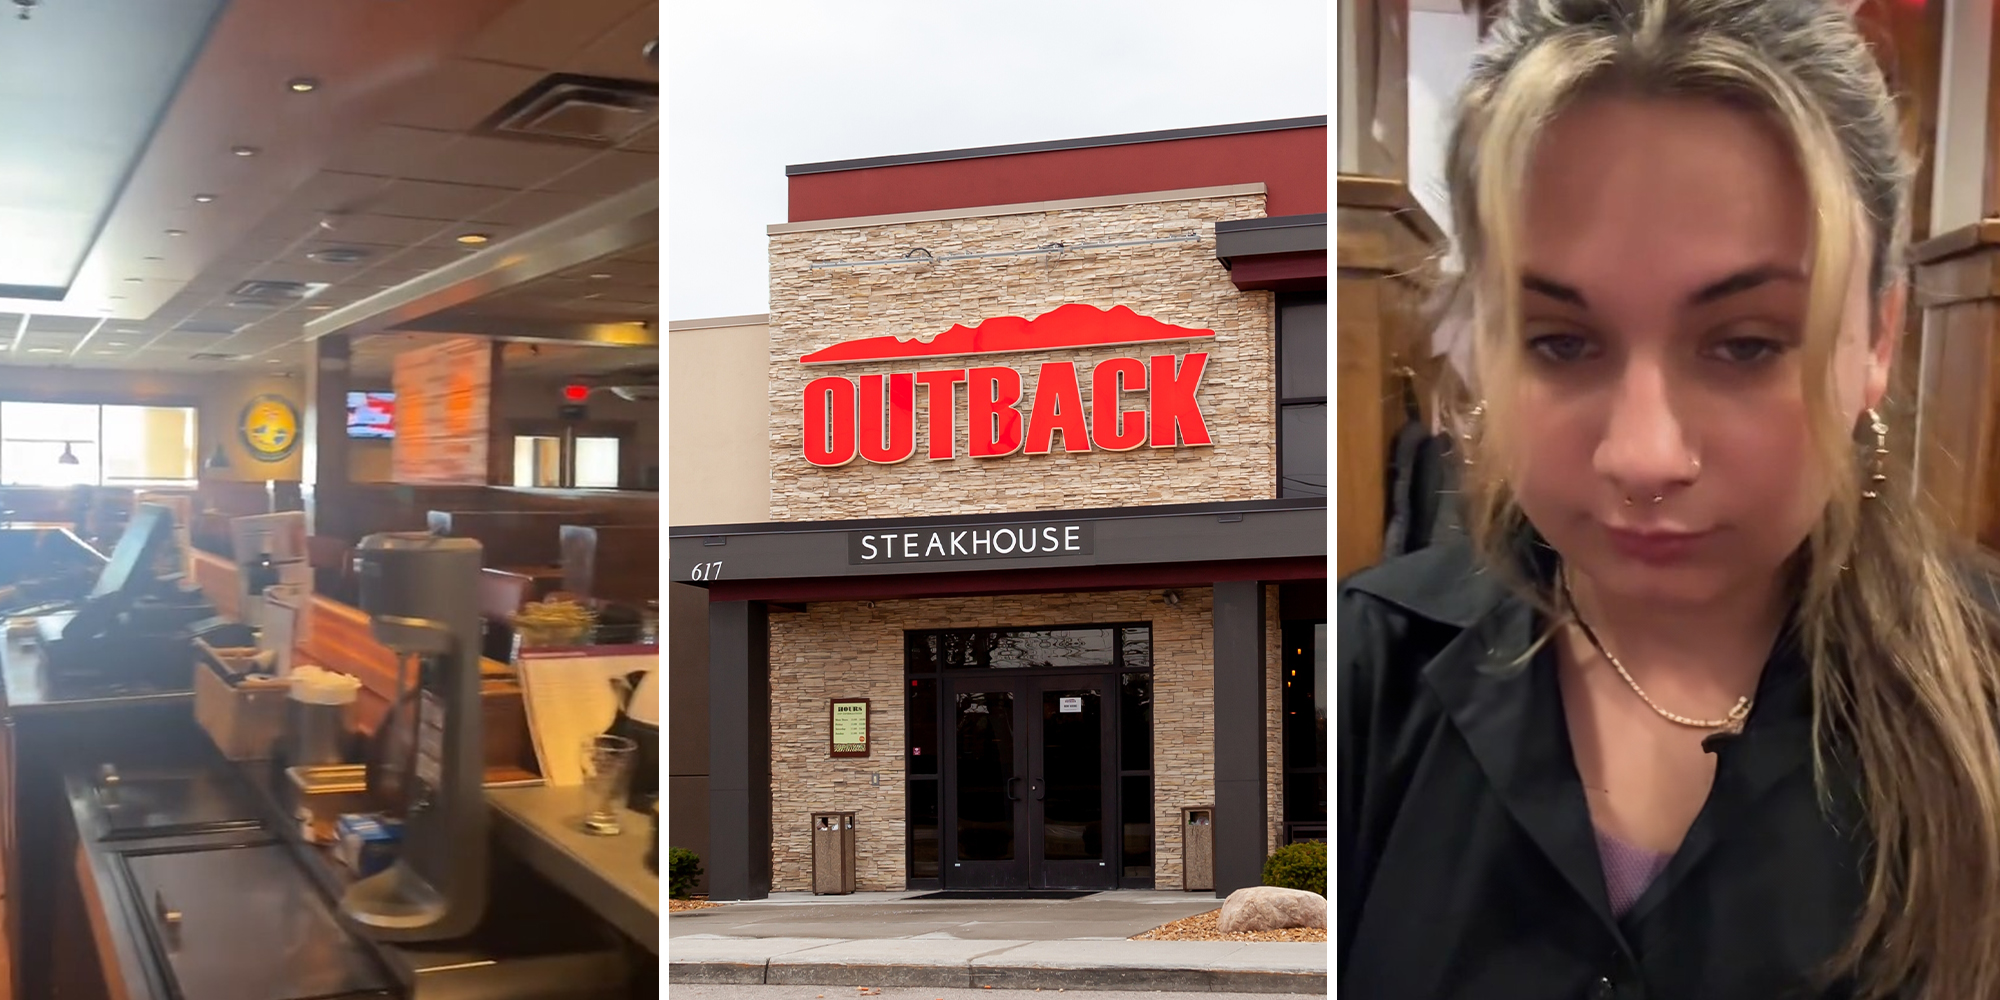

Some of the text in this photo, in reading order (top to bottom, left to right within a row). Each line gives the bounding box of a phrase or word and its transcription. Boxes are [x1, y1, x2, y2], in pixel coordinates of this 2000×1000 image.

[803, 352, 1214, 467] OUTBACK
[861, 525, 1081, 560] STEAKHOUSE
[691, 561, 723, 581] 617
